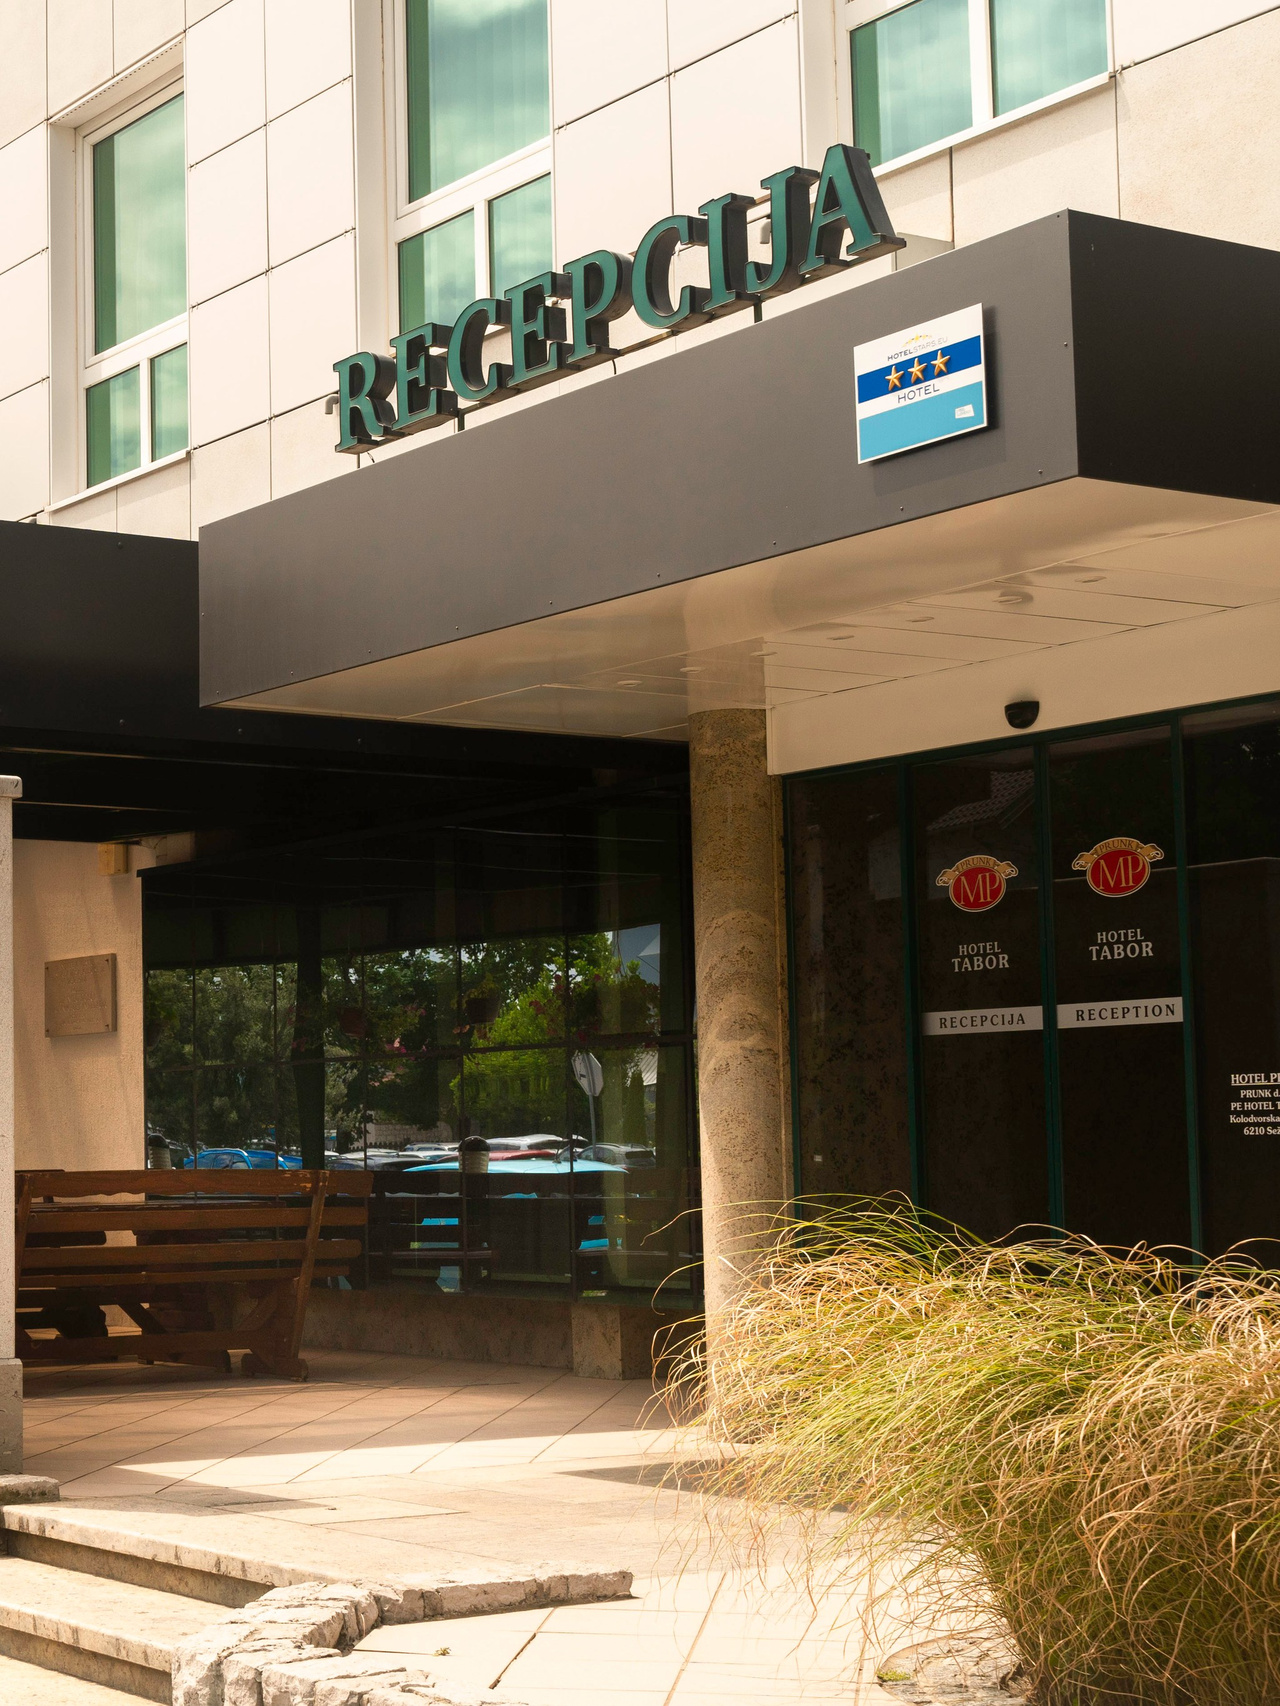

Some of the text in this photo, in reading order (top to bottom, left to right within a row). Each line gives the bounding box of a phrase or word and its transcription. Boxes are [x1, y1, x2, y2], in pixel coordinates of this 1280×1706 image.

[333, 143, 906, 454] RECEPCIJA
[887, 337, 949, 361] HOTELSTARS.EU
[897, 383, 940, 403] HOTEL
[1100, 839, 1134, 853] PRUNK
[960, 857, 991, 871] PRUNK
[1098, 854, 1144, 890] MP
[960, 871, 1000, 905] MP
[1097, 928, 1145, 943] HOTEL
[958, 941, 1001, 956] HOTEL
[1089, 941, 1154, 961] TABOR
[951, 954, 1009, 972] TABOR
[1075, 1003, 1176, 1022] RECEPTION
[939, 1013, 1026, 1029] RECEPCIJA
[1230, 1072, 1280, 1084] HOTEL P
[1240, 1089, 1272, 1098] PRUNK
[1230, 1101, 1243, 1111] PE
[1244, 1101, 1274, 1111] HOTEL
[1243, 1126, 1265, 1136] 6210
